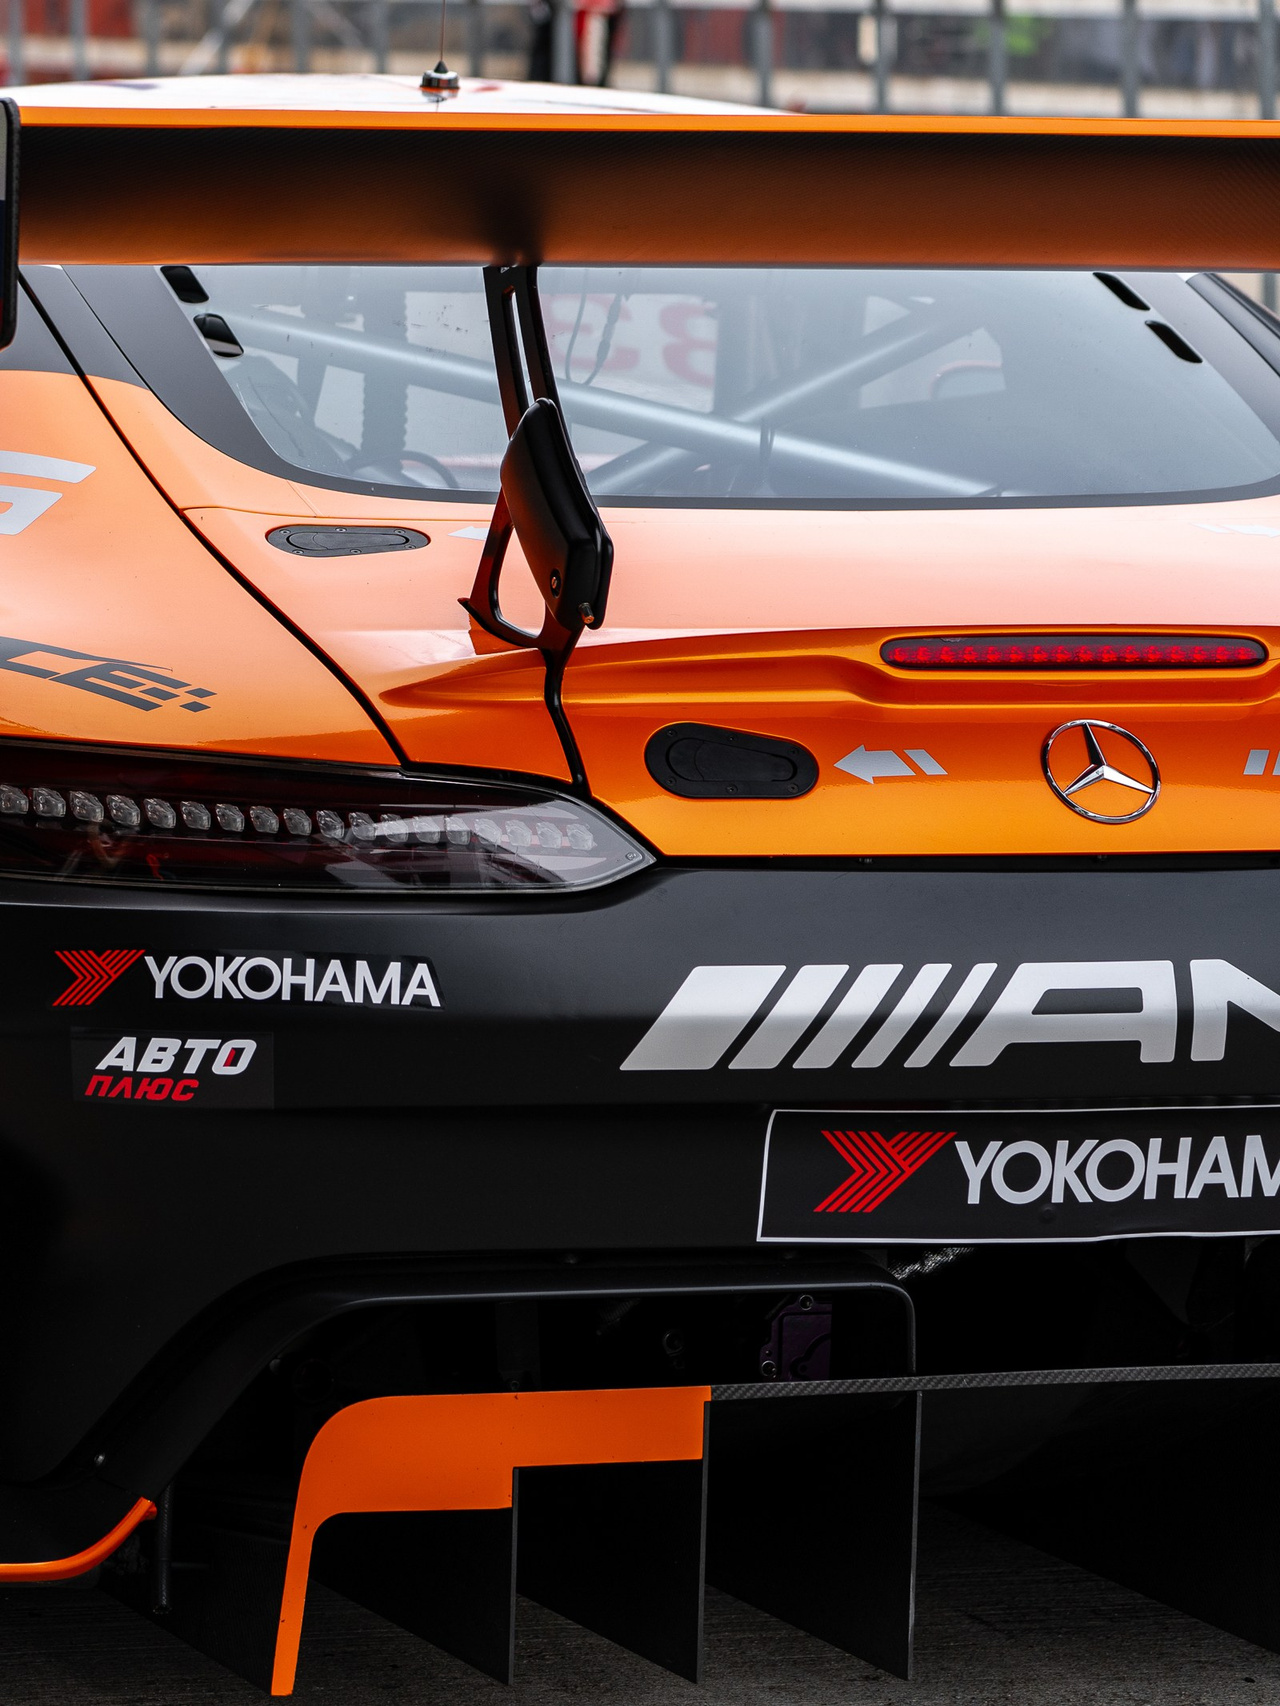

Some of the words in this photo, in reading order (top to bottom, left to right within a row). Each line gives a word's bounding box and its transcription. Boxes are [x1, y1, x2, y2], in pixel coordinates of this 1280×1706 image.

[145, 956, 441, 1007] YOKOHAMA
[95, 1037, 257, 1075] АВТО
[84, 1075, 199, 1101] ПЛЮС
